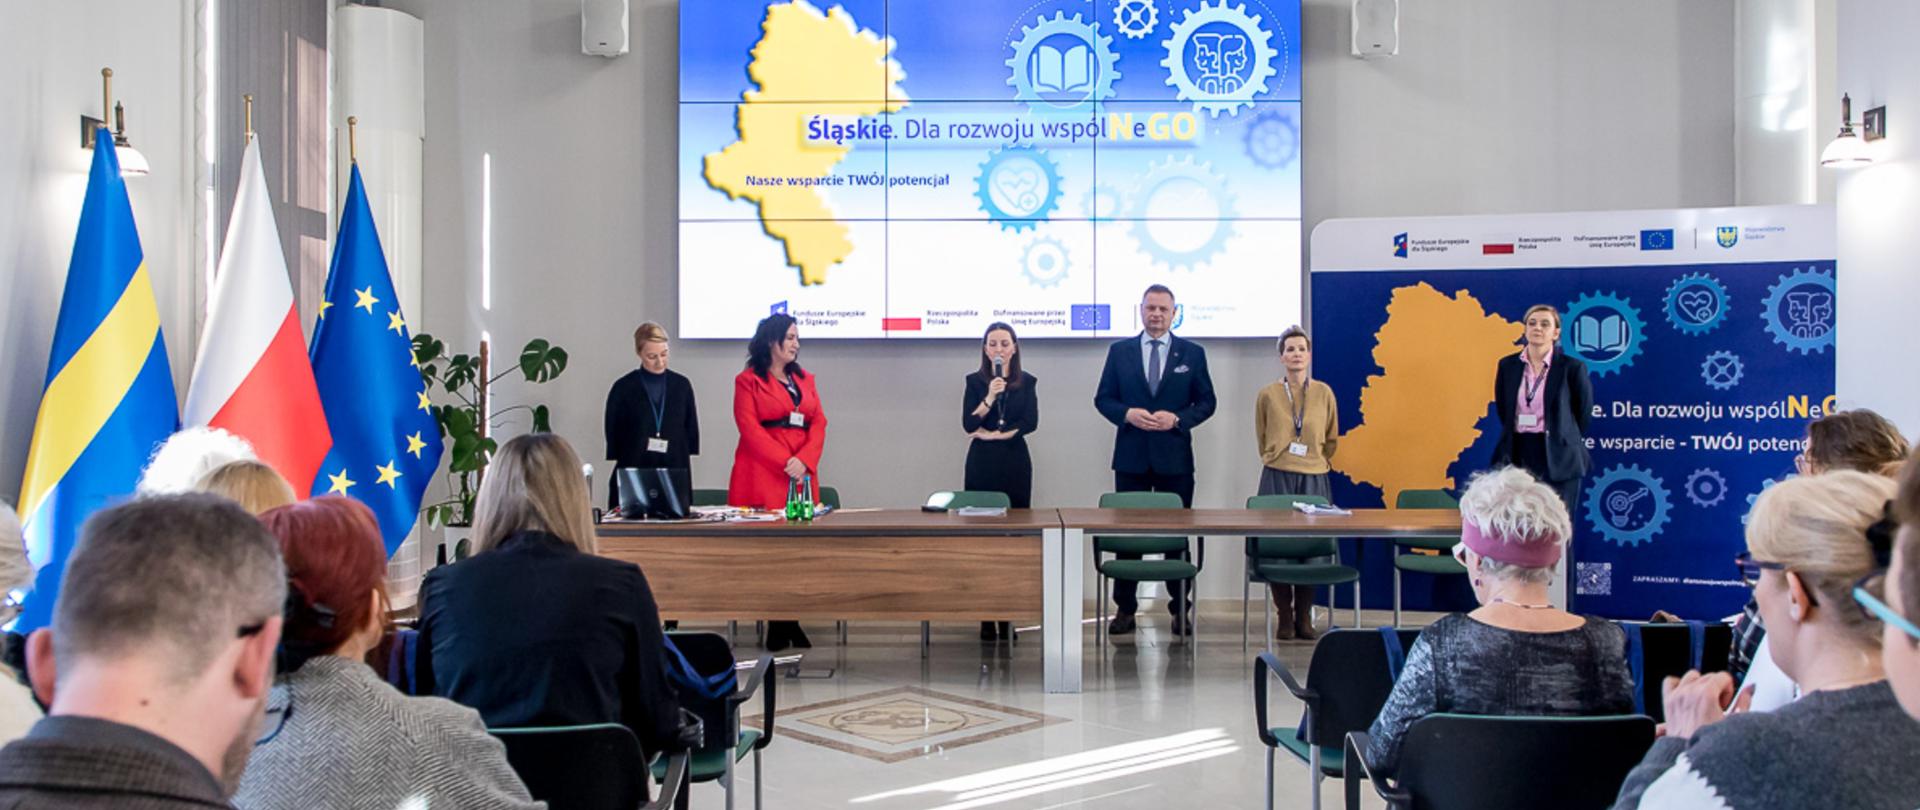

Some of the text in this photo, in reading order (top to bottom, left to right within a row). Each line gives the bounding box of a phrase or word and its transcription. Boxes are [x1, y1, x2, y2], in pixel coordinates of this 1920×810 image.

[808, 115, 898, 144] Śląskie.
[905, 118, 941, 139] Dla
[949, 117, 1034, 143] rozwoju
[745, 172, 950, 189] Nasze wsparcie TWÓJ potencjał
[1612, 401, 1643, 418] Dla
[1648, 402, 1723, 422] rozwoju
[1600, 435, 1675, 453] wsparcie
[1691, 431, 1743, 450] TWÓJ
